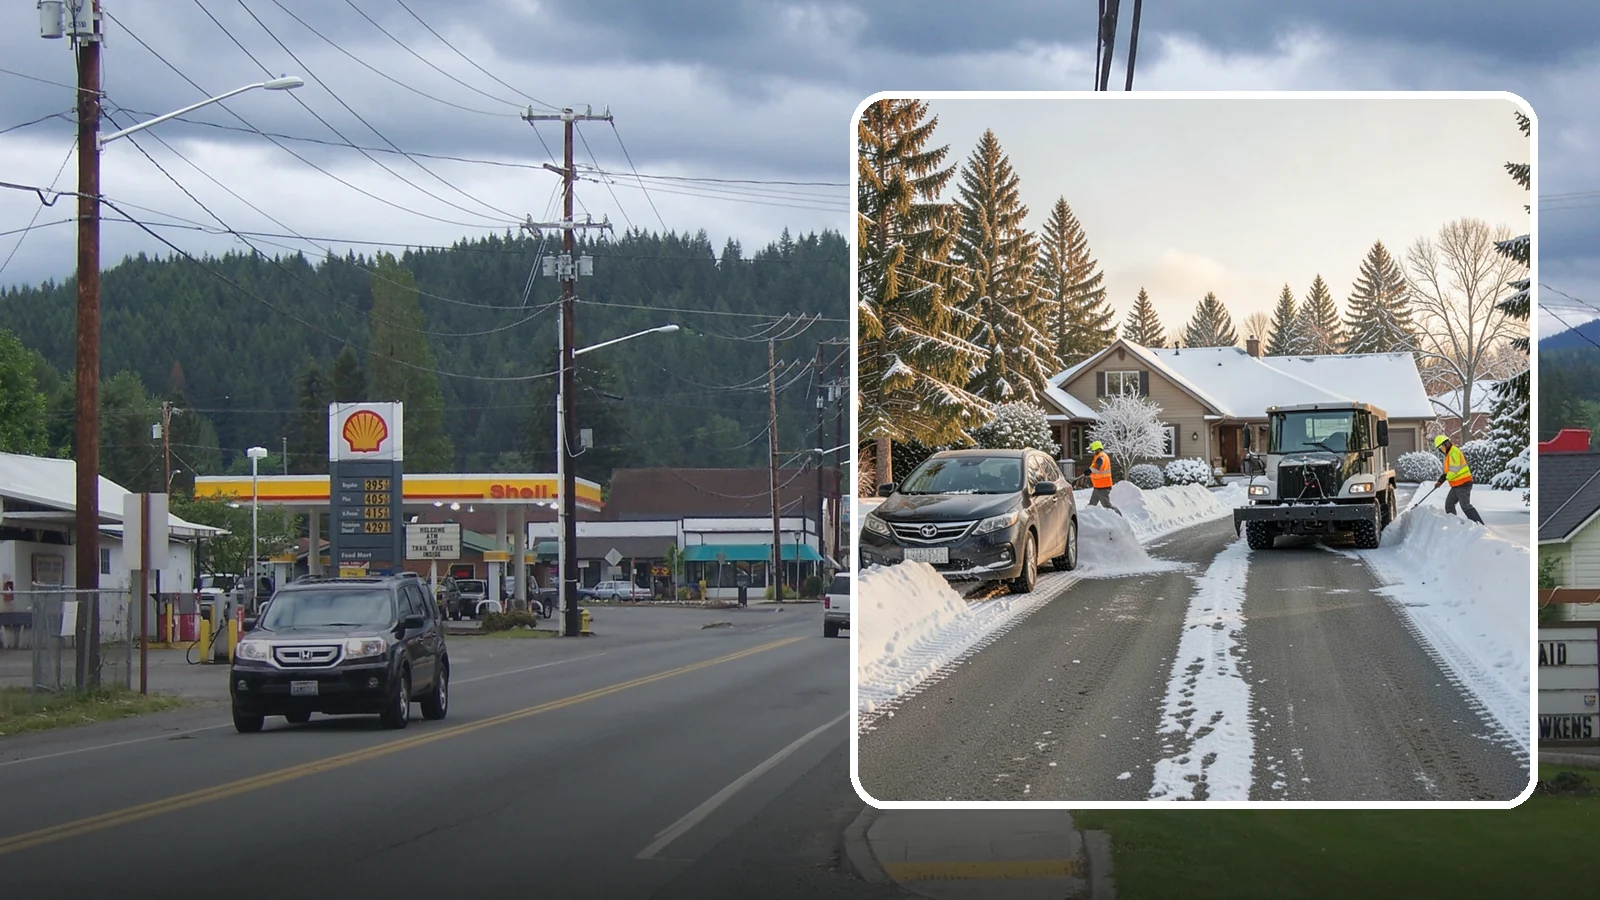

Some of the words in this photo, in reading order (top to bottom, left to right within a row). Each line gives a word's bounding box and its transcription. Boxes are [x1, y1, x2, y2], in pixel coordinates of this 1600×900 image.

[366, 480, 383, 490] 395
[490, 484, 547, 499] Shell
[366, 494, 383, 504] 405
[366, 508, 383, 518] 415
[366, 522, 383, 532] 429
